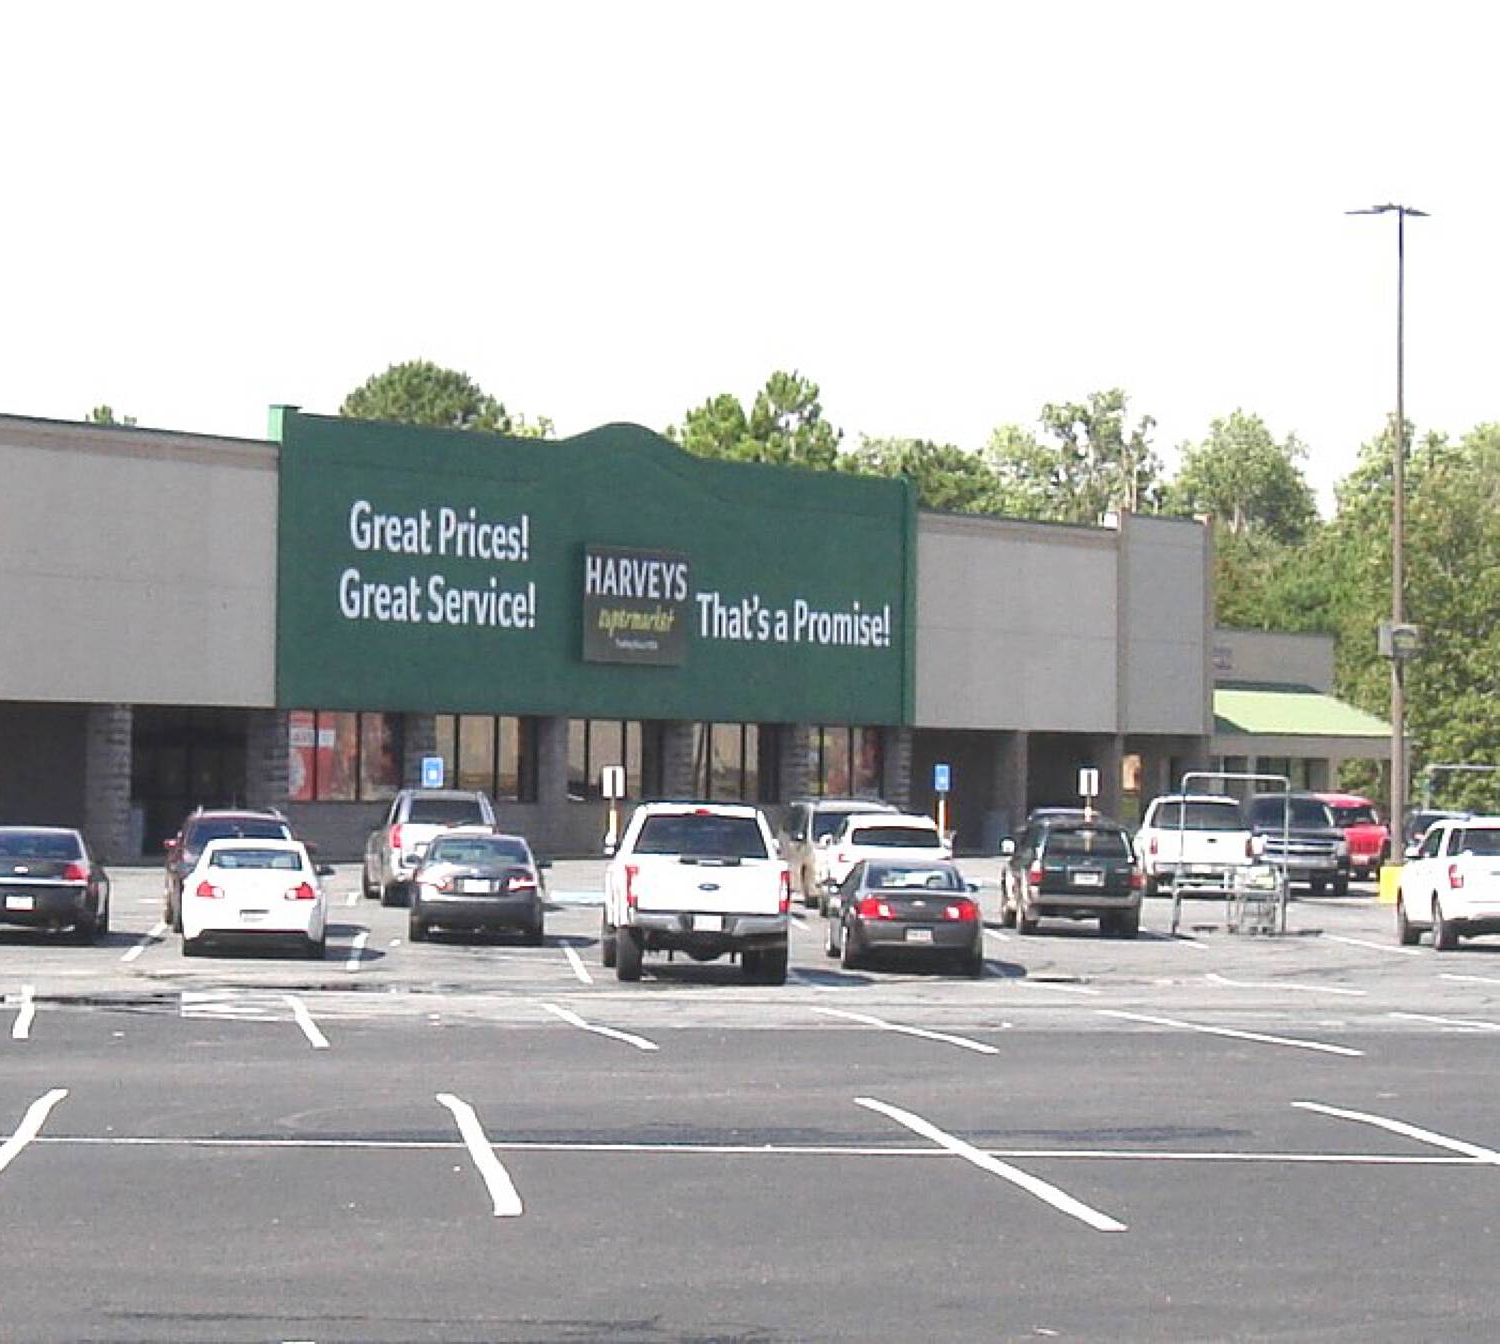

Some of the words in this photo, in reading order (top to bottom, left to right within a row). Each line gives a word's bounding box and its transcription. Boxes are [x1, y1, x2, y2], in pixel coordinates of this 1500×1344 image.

[350, 500, 432, 555] Great
[438, 507, 529, 561] Prices!
[339, 568, 422, 622] Great
[427, 575, 536, 628] Service!
[585, 555, 688, 602] HARVEYS
[696, 591, 770, 641] That's
[775, 609, 789, 642] a
[794, 599, 891, 647] Promise!
